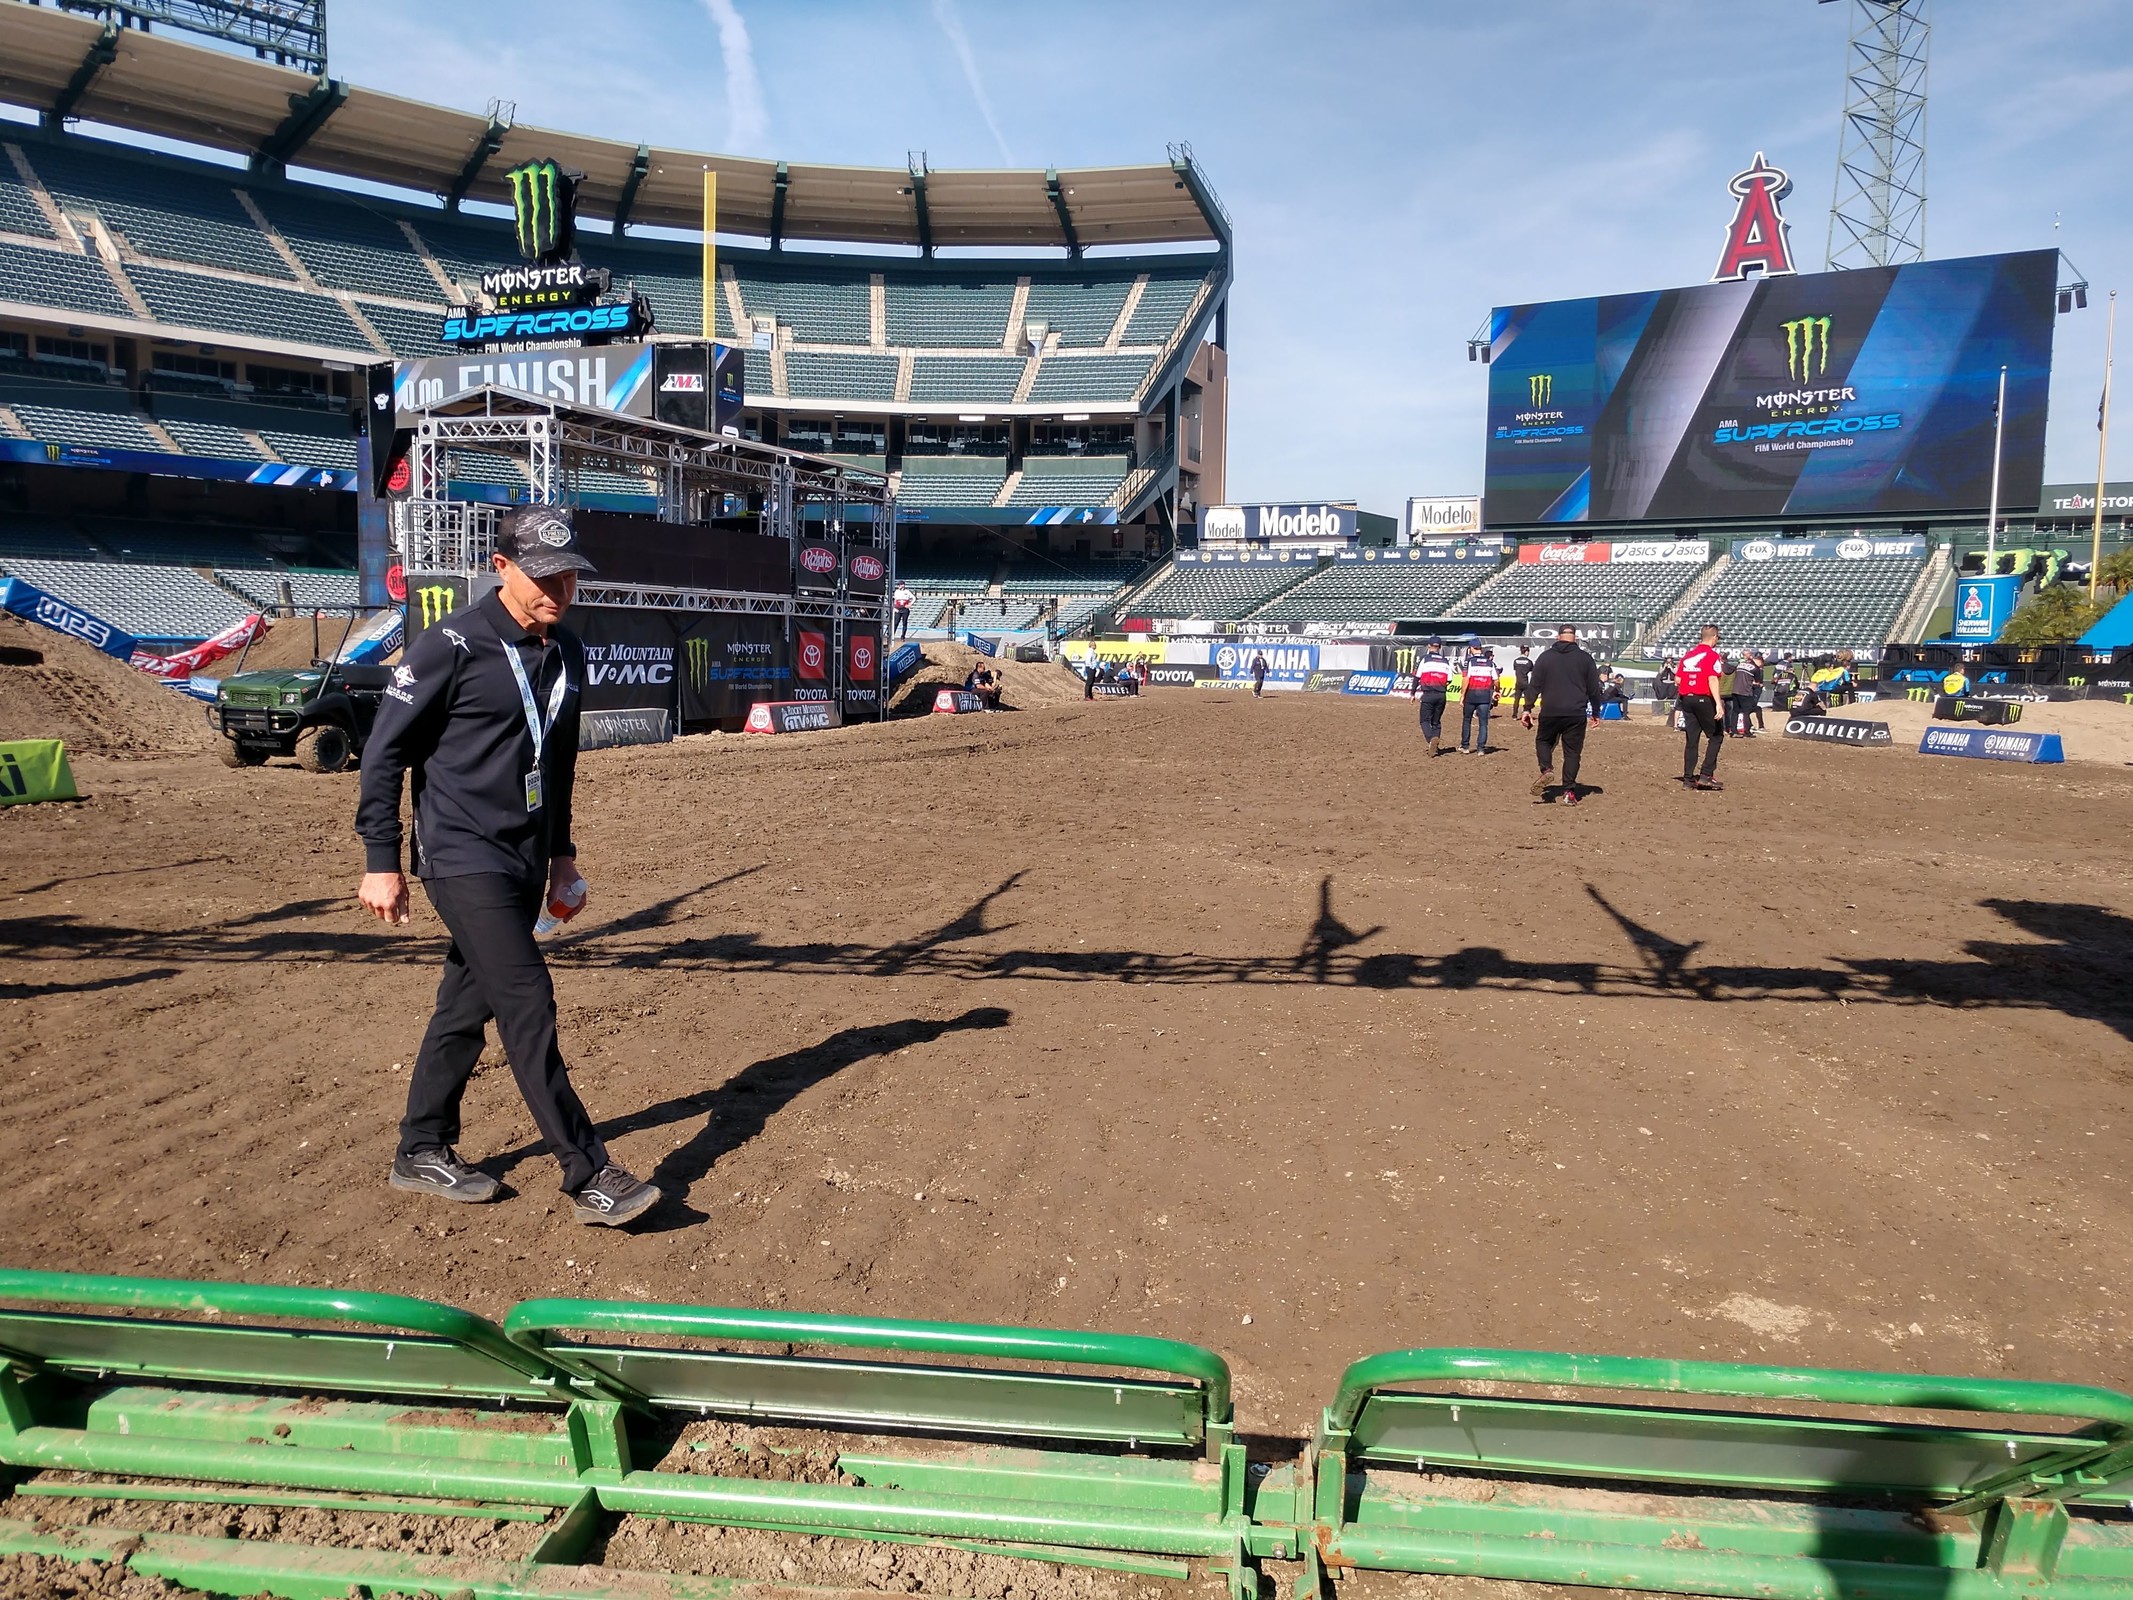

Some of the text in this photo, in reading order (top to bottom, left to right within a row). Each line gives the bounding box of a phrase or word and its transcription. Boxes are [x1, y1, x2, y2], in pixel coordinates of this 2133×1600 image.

[1708, 151, 1797, 283] A
[483, 266, 584, 294] MONSTER
[500, 291, 571, 306] ENERGY
[447, 307, 467, 319] AMA
[442, 306, 630, 341] SUPERCROSS
[485, 338, 582, 354] FIM World Championship
[660, 374, 704, 392] AMA
[1756, 387, 1856, 409] MONSTER
[1515, 411, 1564, 422] MONSTER
[1771, 405, 1840, 418] ENERGY
[1713, 413, 1901, 444] SUPERCROSS
[1719, 419, 1738, 428] AMA
[1495, 425, 1585, 439] SUPERCROSS
[1755, 438, 1854, 453] FIM World Championship
[2053, 494, 2095, 510] TEAM
[1259, 506, 1340, 537] Modelo
[1422, 505, 1472, 525] Modelo
[1208, 523, 1243, 538] Modelo
[1629, 544, 1706, 556] asics asics
[1749, 545, 1768, 554] FOX
[1776, 544, 1815, 557] WEST
[1844, 543, 1864, 552] FOX
[1873, 542, 1914, 555] WEST
[804, 550, 833, 573] Ralphs
[854, 557, 881, 579] Ralphs
[36, 596, 110, 648] WPS
[1237, 624, 1290, 634] MONSTER
[1318, 621, 1389, 630] ROCKY MOUNTAIN
[1958, 619, 1989, 627] SHERWIN
[1957, 626, 1989, 634] WILLIAMS
[1255, 635, 1332, 645] ROCKY MOUNTAIN
[607, 644, 675, 661] MOUNTAIN
[727, 641, 772, 655] MONSTER
[1662, 648, 1685, 658] MLB
[710, 667, 791, 680] SUPERCROSS
[1151, 670, 1195, 682] TOYOTA
[1222, 670, 1305, 679] RANG
[1201, 681, 1247, 689] SUZUKI
[1357, 674, 1391, 689] YAMAHA
[2098, 679, 2131, 688] MONSTER
[794, 688, 828, 701] TOYOTA
[847, 689, 876, 701] TOYOTA
[594, 715, 651, 734] MONSTER
[1804, 722, 1868, 740] OAKLEY
[1936, 731, 1970, 747] YAMAHA
[1993, 734, 2032, 752] YAMAHA
[1928, 744, 1964, 752] RACING
[1985, 749, 2025, 757] RACING
